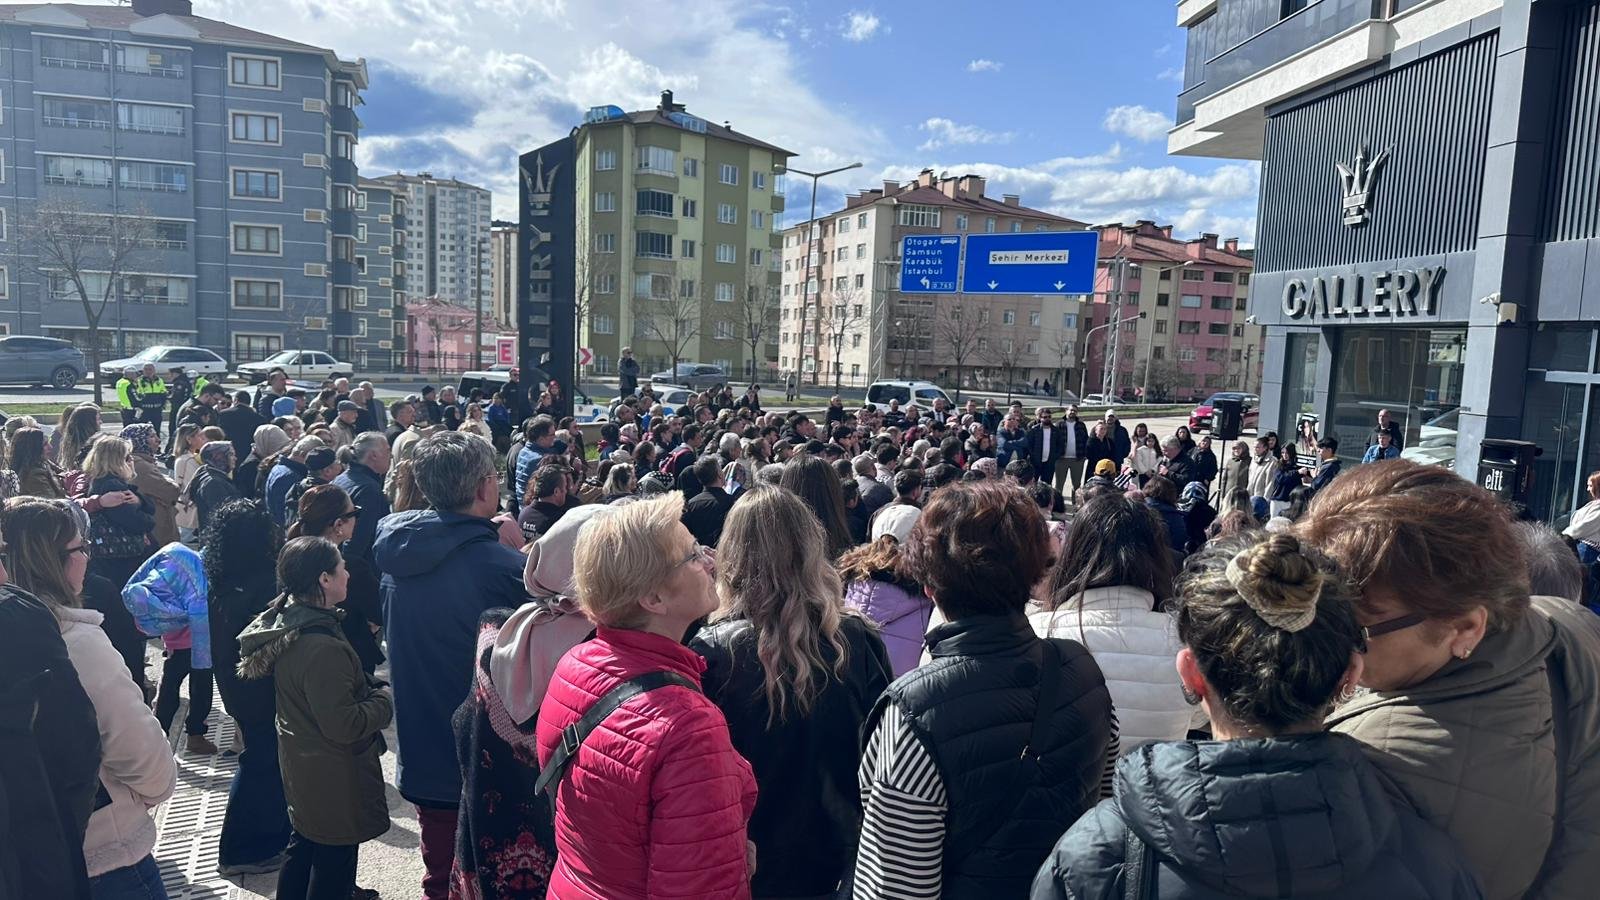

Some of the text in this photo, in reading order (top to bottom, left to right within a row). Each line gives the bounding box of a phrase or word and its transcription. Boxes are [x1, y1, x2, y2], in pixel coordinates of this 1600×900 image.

[906, 238, 938, 247] Otogar
[905, 247, 943, 256] Samsun
[905, 256, 943, 265] Karabük
[991, 252, 1067, 263] Şehir Merkezi
[904, 265, 943, 275] İstanbul
[1282, 265, 1446, 317] GALLERY
[501, 343, 513, 362] E
[1484, 468, 1504, 491] elit
